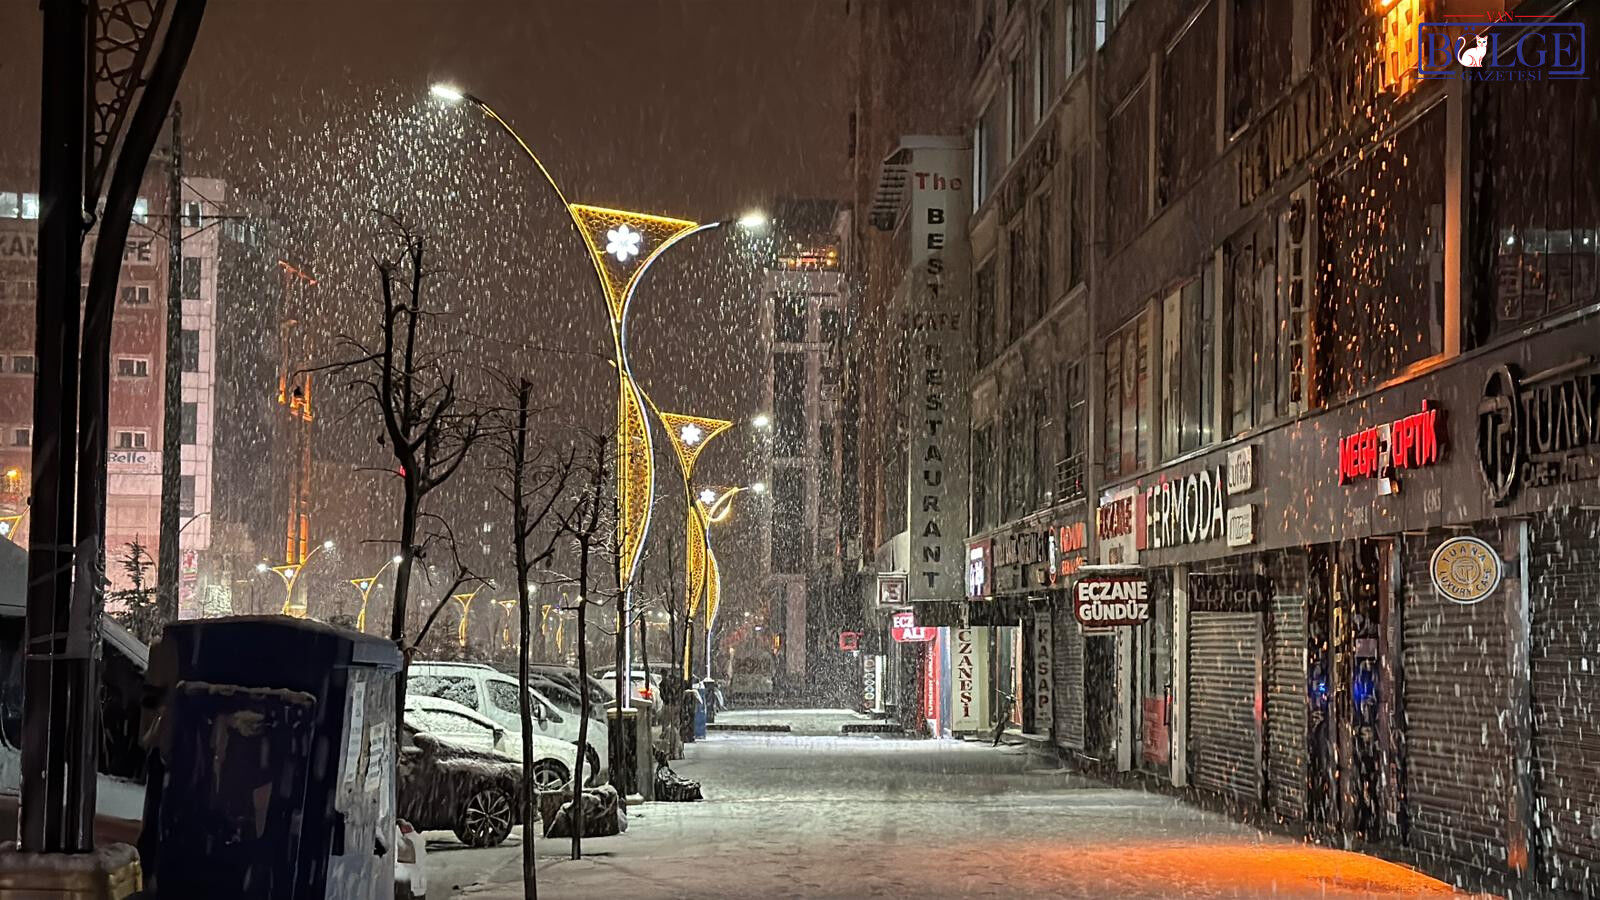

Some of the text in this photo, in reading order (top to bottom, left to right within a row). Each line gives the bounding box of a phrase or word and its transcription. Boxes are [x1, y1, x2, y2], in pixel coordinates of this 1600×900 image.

[915, 172, 962, 191] The
[107, 452, 146, 463] Belle
[1337, 424, 1378, 488] MEGA
[1146, 464, 1225, 550] FERMODA
[1078, 581, 1148, 601] ECZANE
[1078, 601, 1149, 621] GÜNDÜZ
[1038, 629, 1049, 708] KASAP
